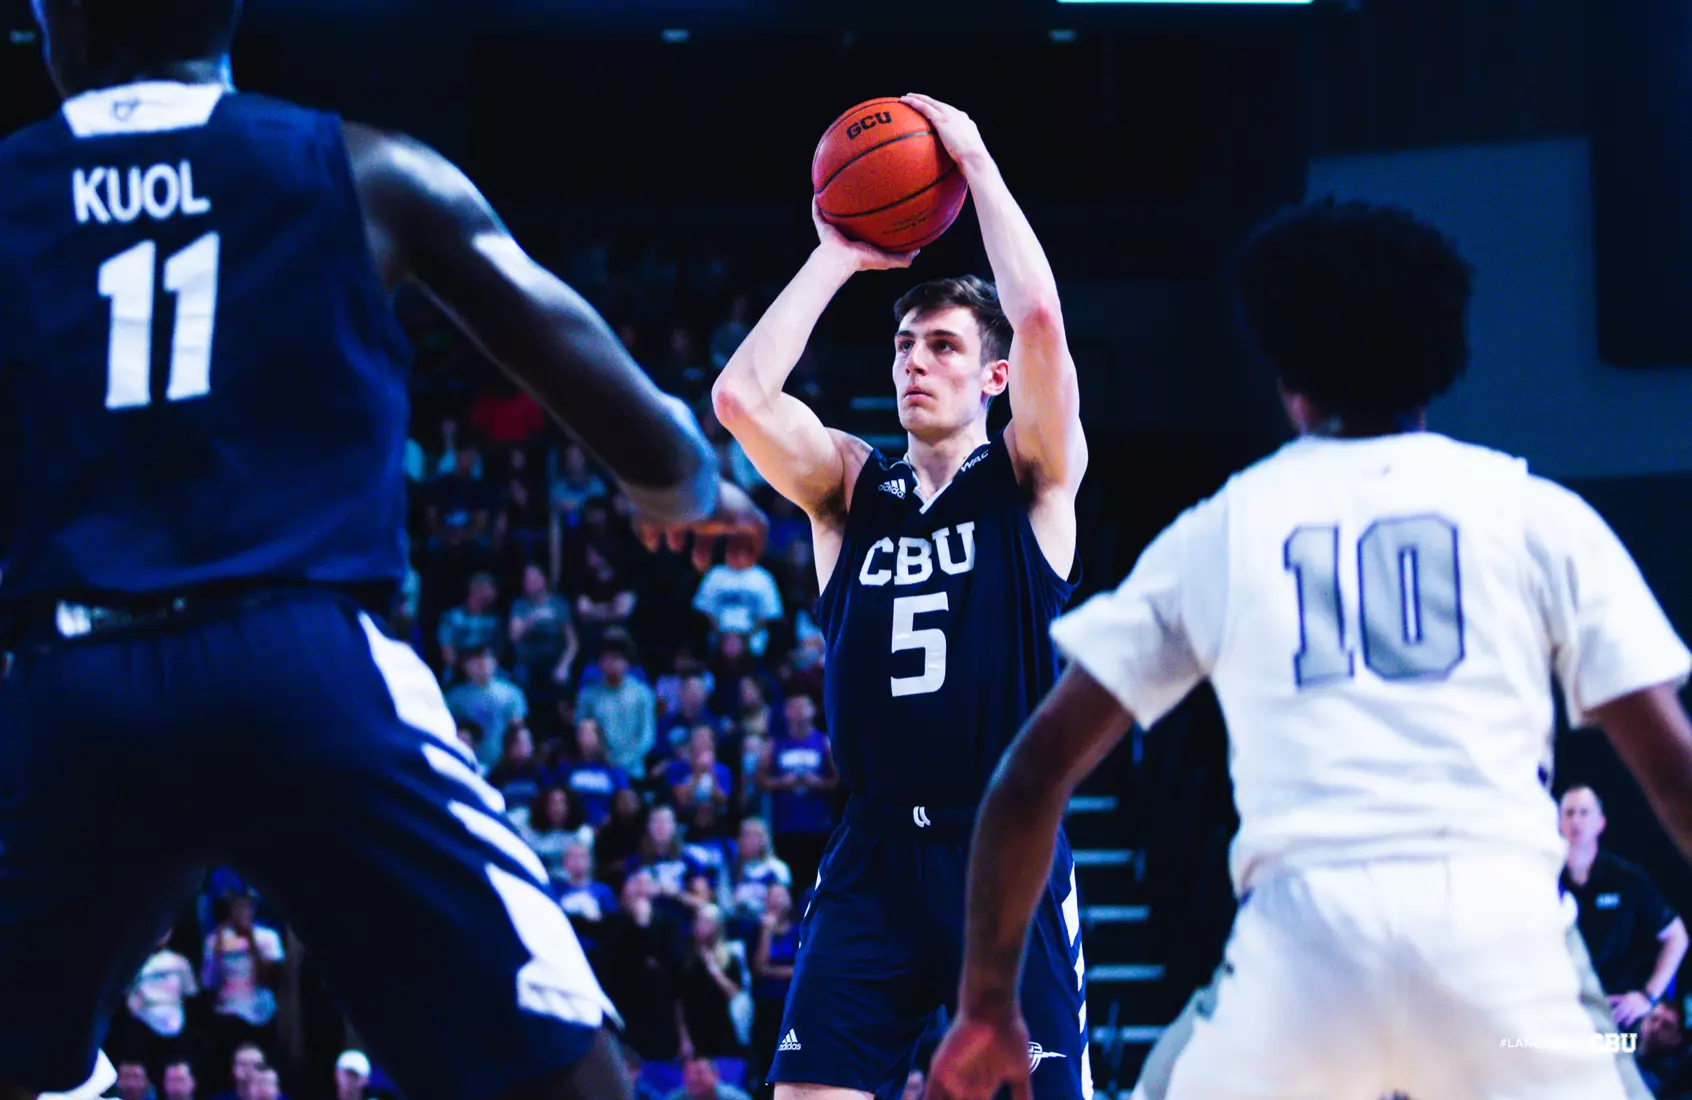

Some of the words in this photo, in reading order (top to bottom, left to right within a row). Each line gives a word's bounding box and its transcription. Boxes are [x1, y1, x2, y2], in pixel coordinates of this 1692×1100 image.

[847, 111, 892, 140] GCU
[72, 157, 211, 224] KUOL
[97, 230, 220, 410] 11
[960, 449, 989, 473] WAC
[858, 521, 976, 587] CBU
[1283, 513, 1466, 688] 10
[890, 591, 949, 697] 5
